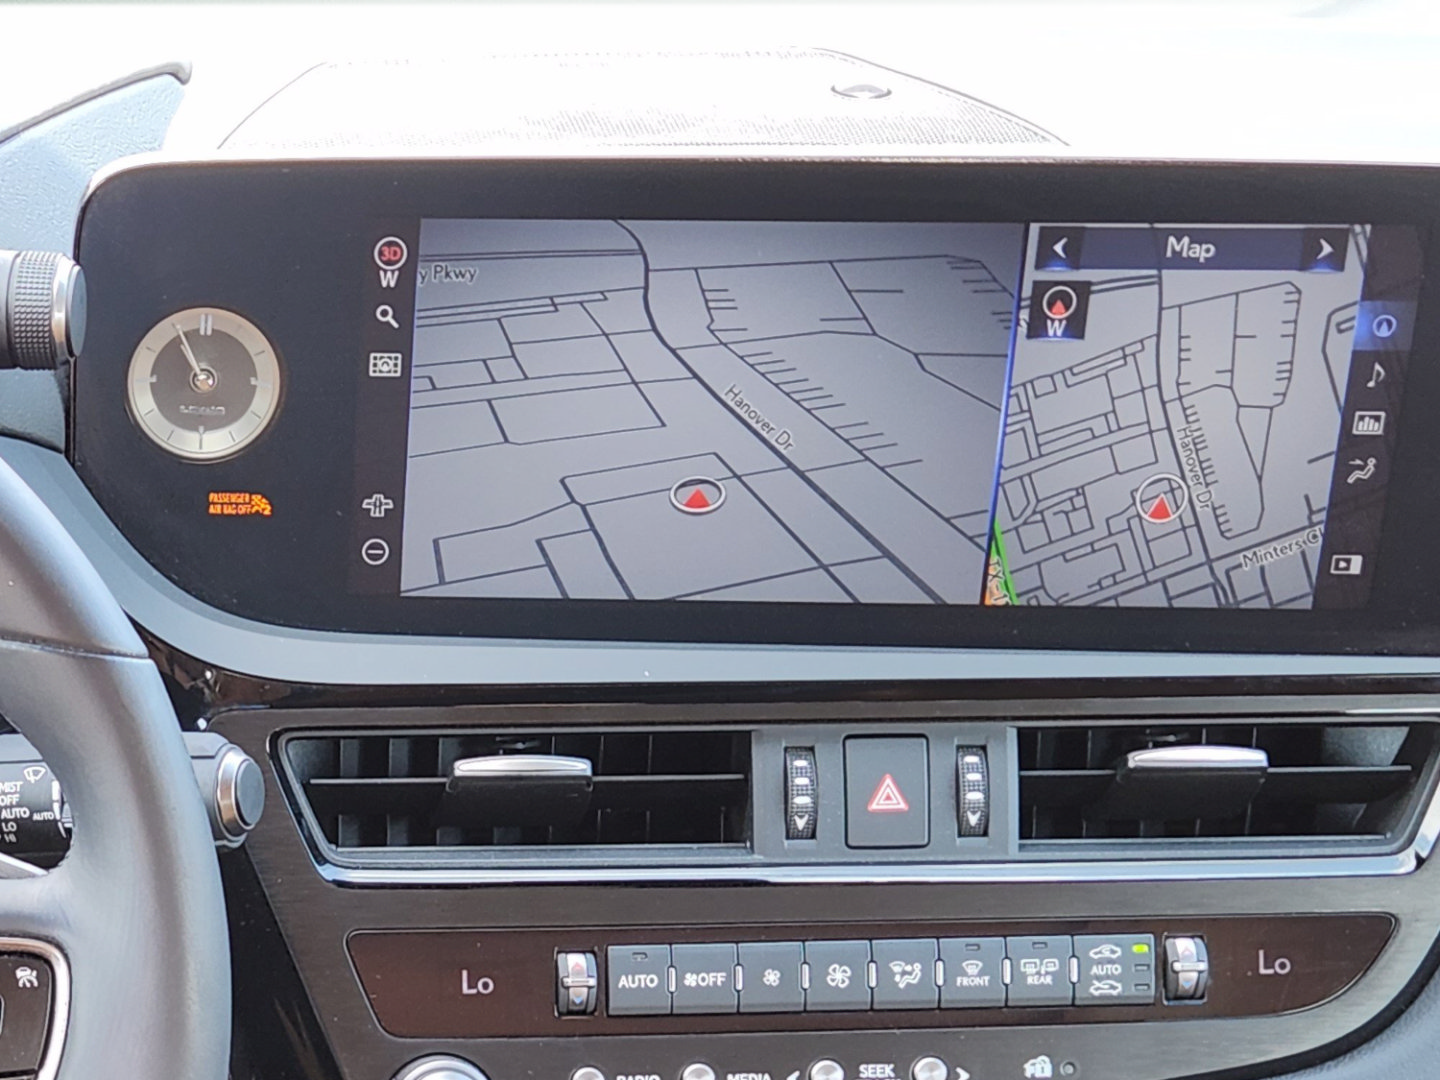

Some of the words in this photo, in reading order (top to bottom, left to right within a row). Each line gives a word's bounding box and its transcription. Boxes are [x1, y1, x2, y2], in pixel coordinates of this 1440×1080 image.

[380, 246, 401, 261] 3D
[1166, 235, 1216, 263] Map
[379, 270, 399, 288] W
[433, 264, 477, 282] Pkwy
[1047, 319, 1067, 337] W
[724, 384, 776, 434] Hanover
[775, 430, 793, 450] Dr
[1176, 425, 1203, 486] Hanover
[1196, 490, 1212, 508] Dr
[1242, 540, 1304, 568] Minters
[1, 807, 30, 819] AUTO
[32, 811, 54, 821] AUTO
[1, 821, 17, 832] LO
[1258, 949, 1291, 975] Lo
[1090, 964, 1122, 976] AUTO
[461, 969, 494, 996] Lo
[618, 974, 658, 989] AUTO
[698, 972, 726, 987] OFF
[956, 976, 990, 987] FRONT
[1027, 974, 1053, 985] REAR
[859, 1064, 896, 1078] SEEK
